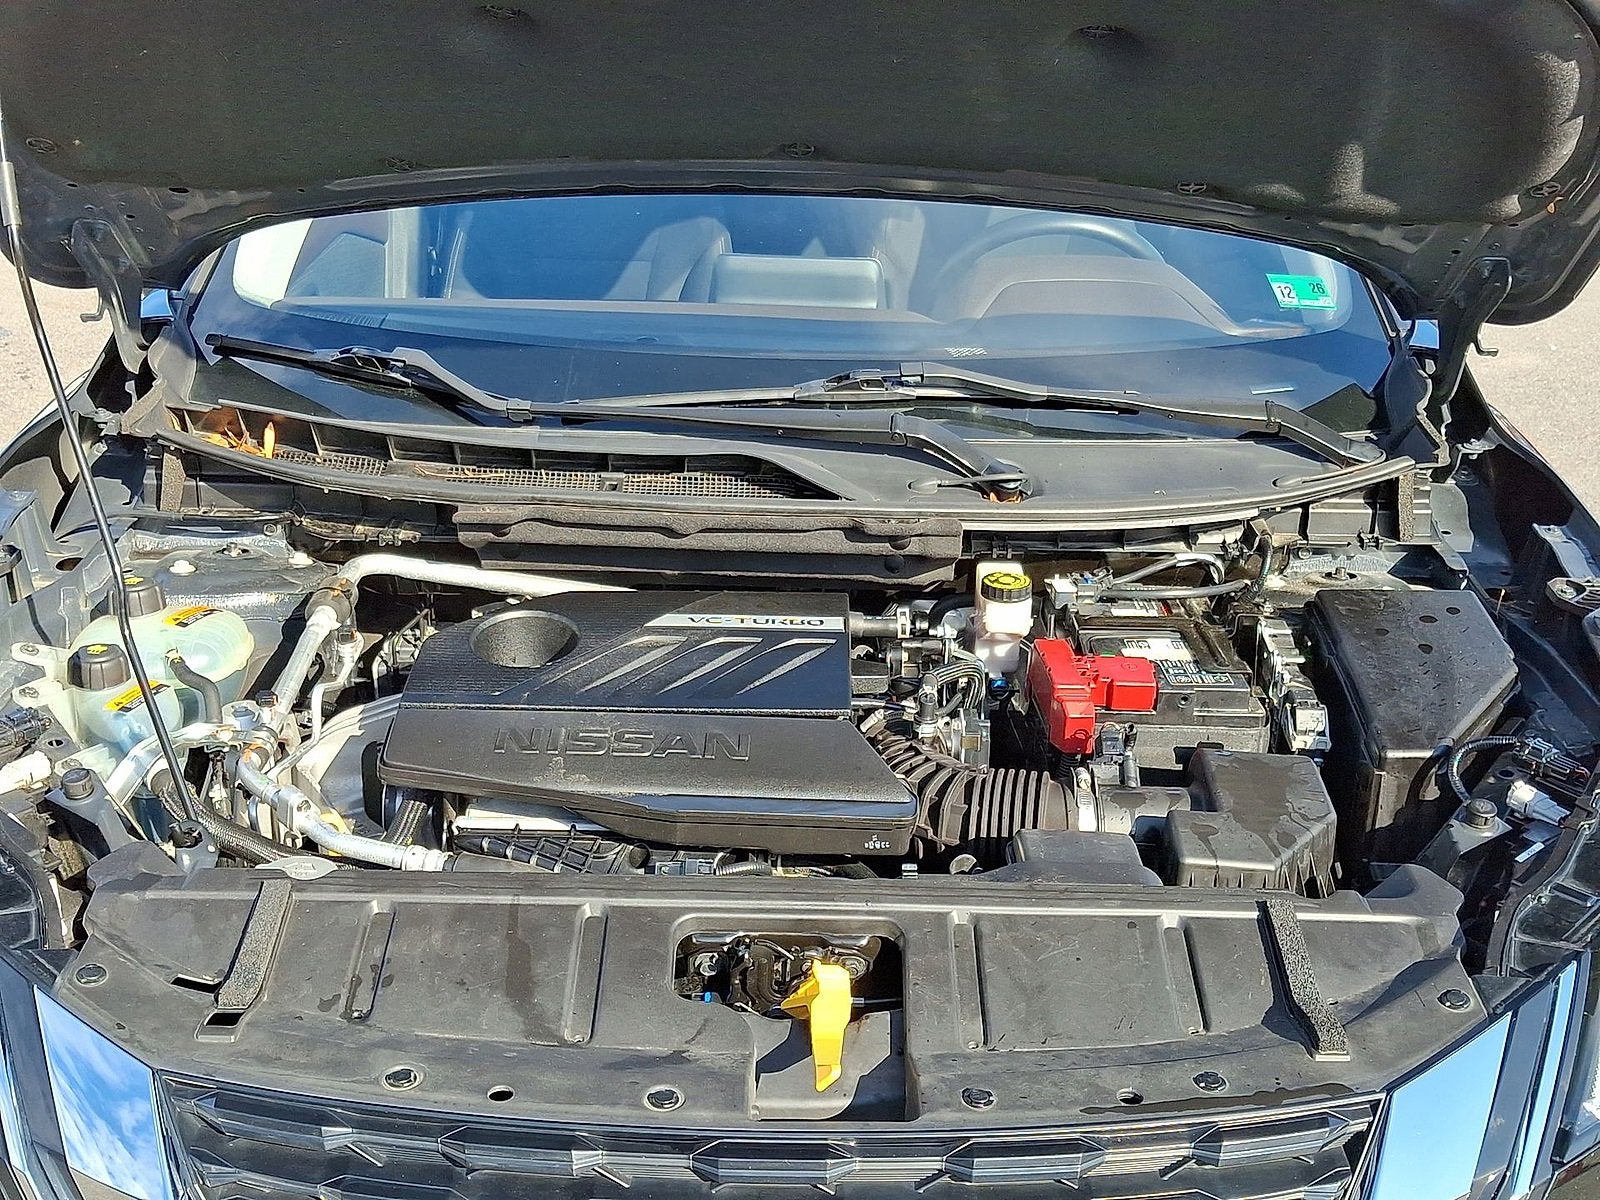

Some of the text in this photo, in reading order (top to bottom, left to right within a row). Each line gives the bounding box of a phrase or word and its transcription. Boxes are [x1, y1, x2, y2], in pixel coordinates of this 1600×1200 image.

[1276, 282, 1326, 299] 12 26
[687, 616, 825, 626] VC-TURBO
[494, 727, 751, 761] NISSAN
